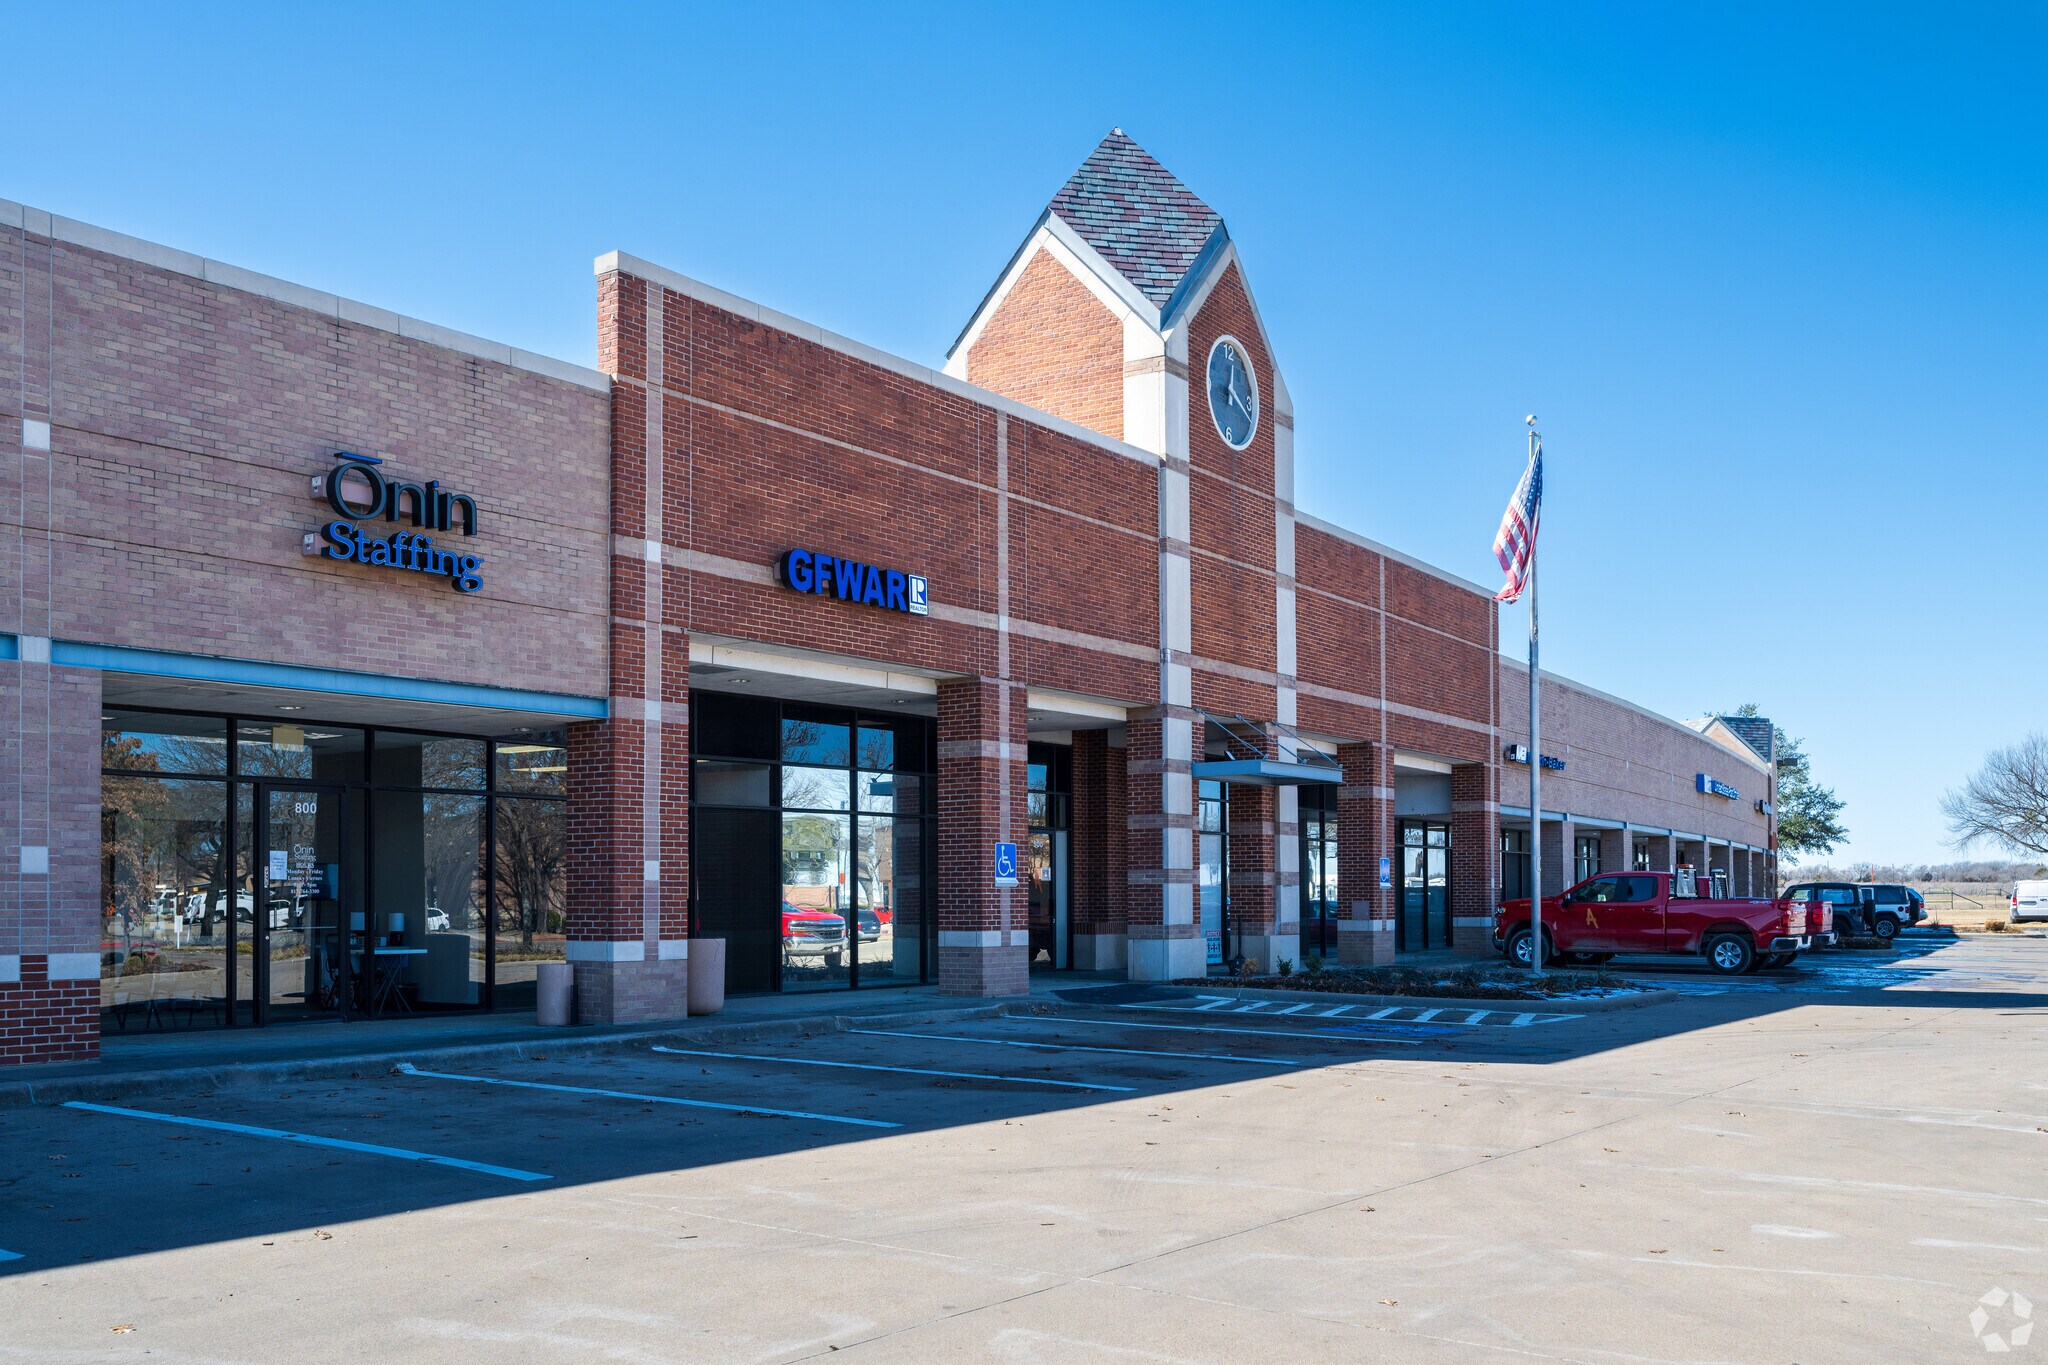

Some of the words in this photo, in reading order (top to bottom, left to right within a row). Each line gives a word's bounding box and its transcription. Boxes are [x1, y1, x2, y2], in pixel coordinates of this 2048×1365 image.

[1223, 343, 1234, 361] 12
[1246, 395, 1252, 411] 3
[1225, 427, 1233, 443] 6
[322, 520, 485, 593] Staffing
[781, 548, 908, 611] GFWAR
[910, 604, 928, 613] REALTOR
[295, 802, 317, 814] 800
[294, 854, 317, 862] Staffing
[1586, 907, 1599, 929] A
